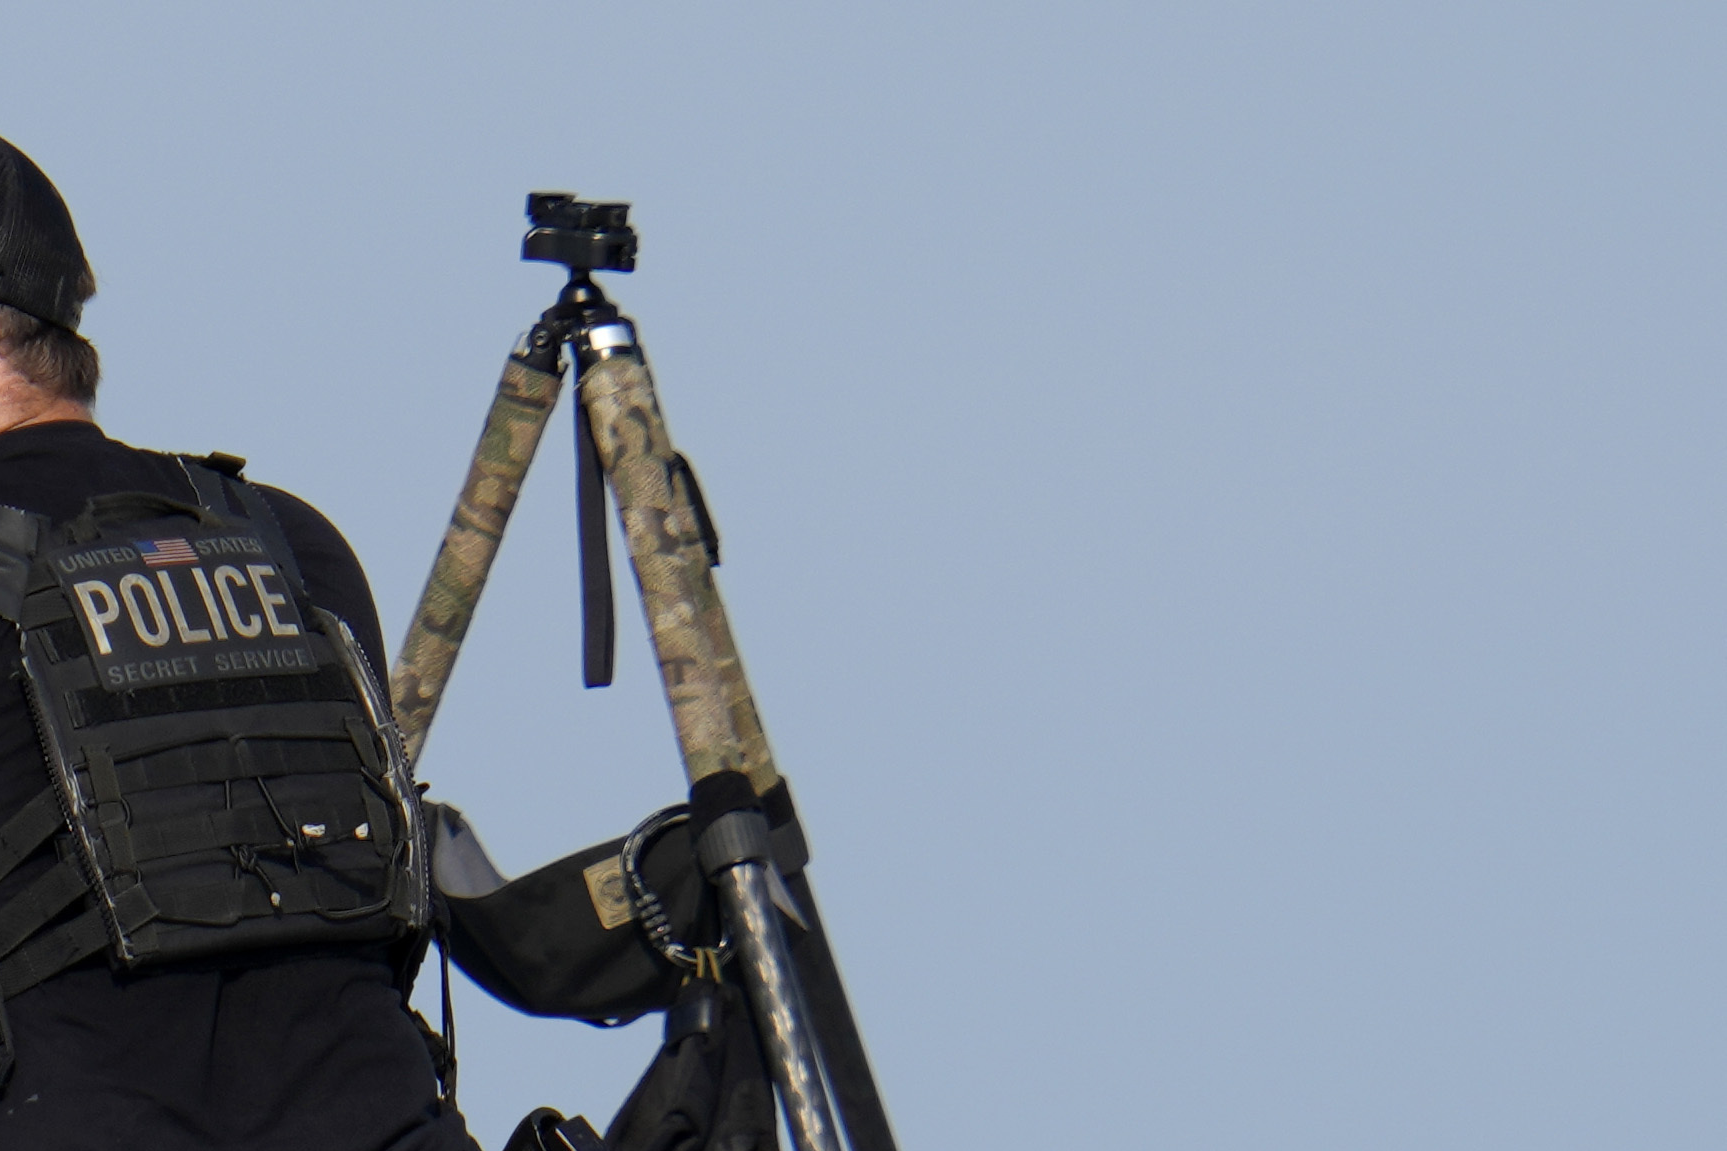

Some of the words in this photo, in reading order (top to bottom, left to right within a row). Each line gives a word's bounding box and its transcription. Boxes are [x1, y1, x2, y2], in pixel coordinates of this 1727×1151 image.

[59, 547, 136, 573] UNITED
[194, 537, 263, 556] STATES
[74, 564, 300, 655] POLICE
[108, 656, 198, 684] SECRET
[215, 649, 310, 671] SERVICE
